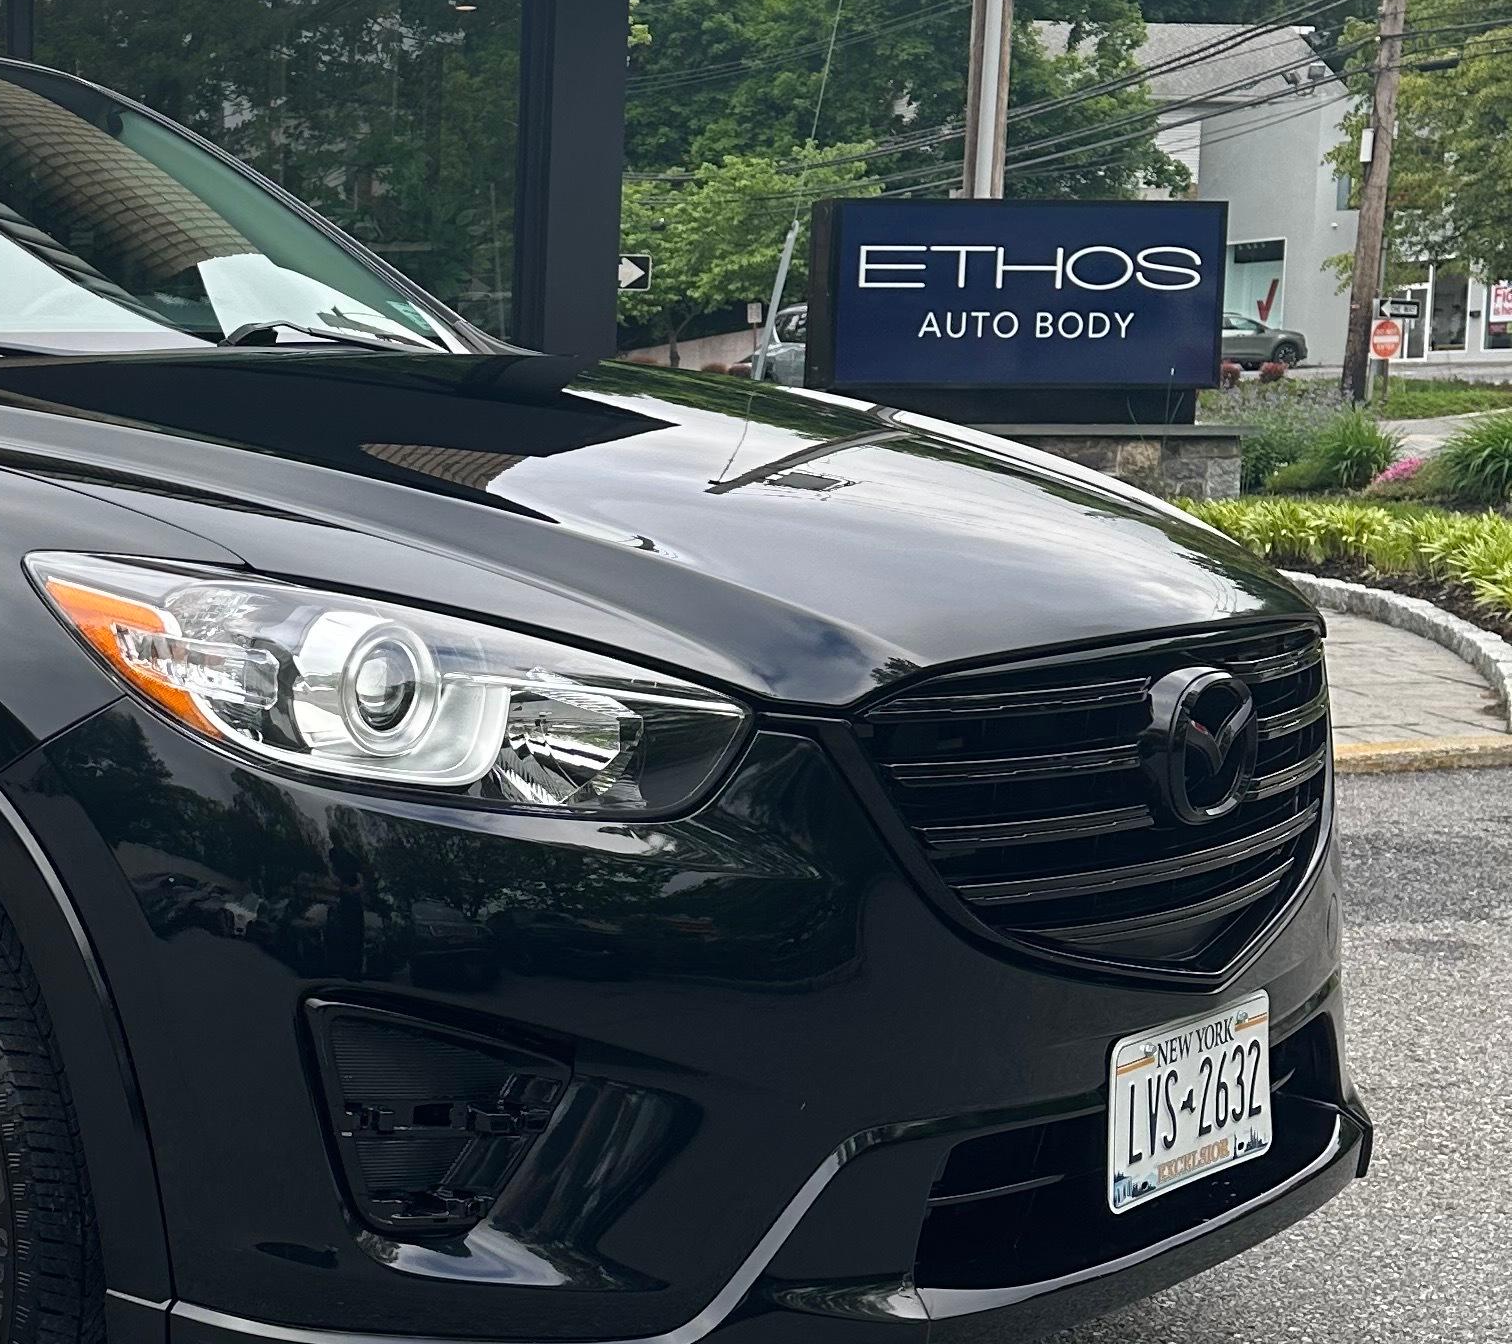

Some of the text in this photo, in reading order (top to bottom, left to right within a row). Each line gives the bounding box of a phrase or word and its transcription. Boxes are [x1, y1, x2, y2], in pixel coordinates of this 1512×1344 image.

[858, 245, 1202, 291] ETHOS
[918, 311, 1135, 339] AUTO BODY
[1156, 1016, 1234, 1068] NEW YORK
[1128, 1038, 1262, 1165] LVS 2632
